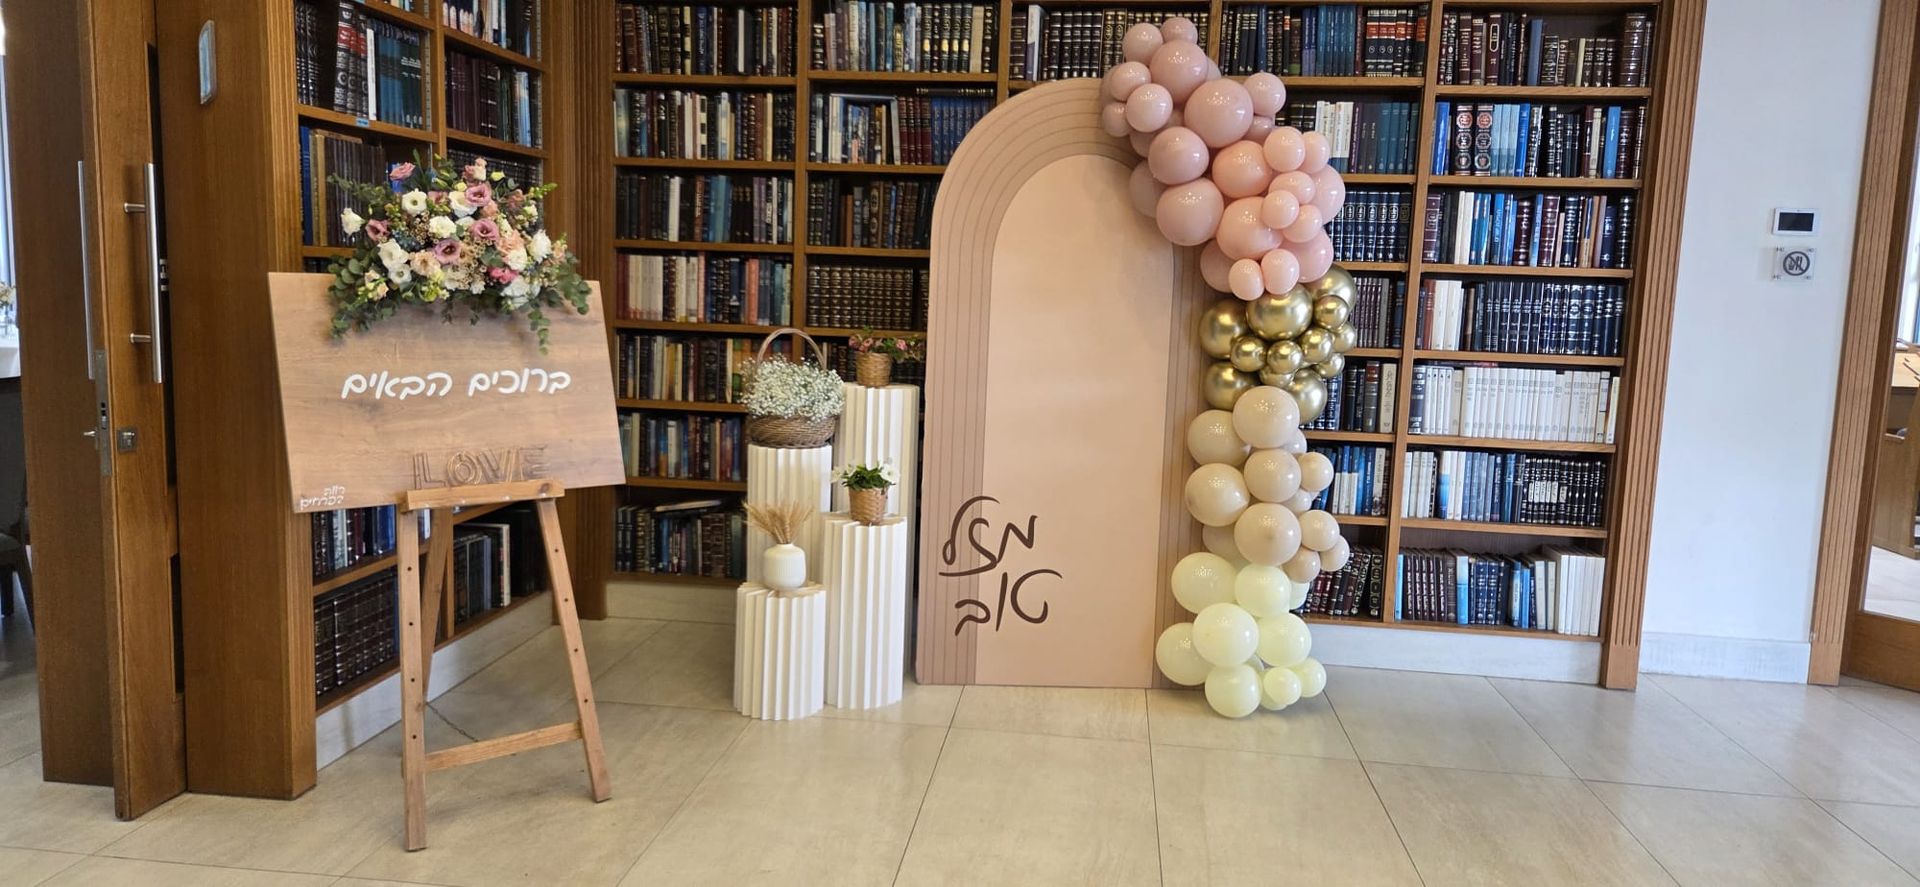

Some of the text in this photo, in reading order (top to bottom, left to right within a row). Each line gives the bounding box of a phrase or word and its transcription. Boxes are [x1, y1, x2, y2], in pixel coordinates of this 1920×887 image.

[340, 367, 572, 400] ברוכים הבאים
[412, 444, 548, 491] LOVE
[938, 495, 1038, 577] מזל
[954, 568, 1063, 636] טוב
